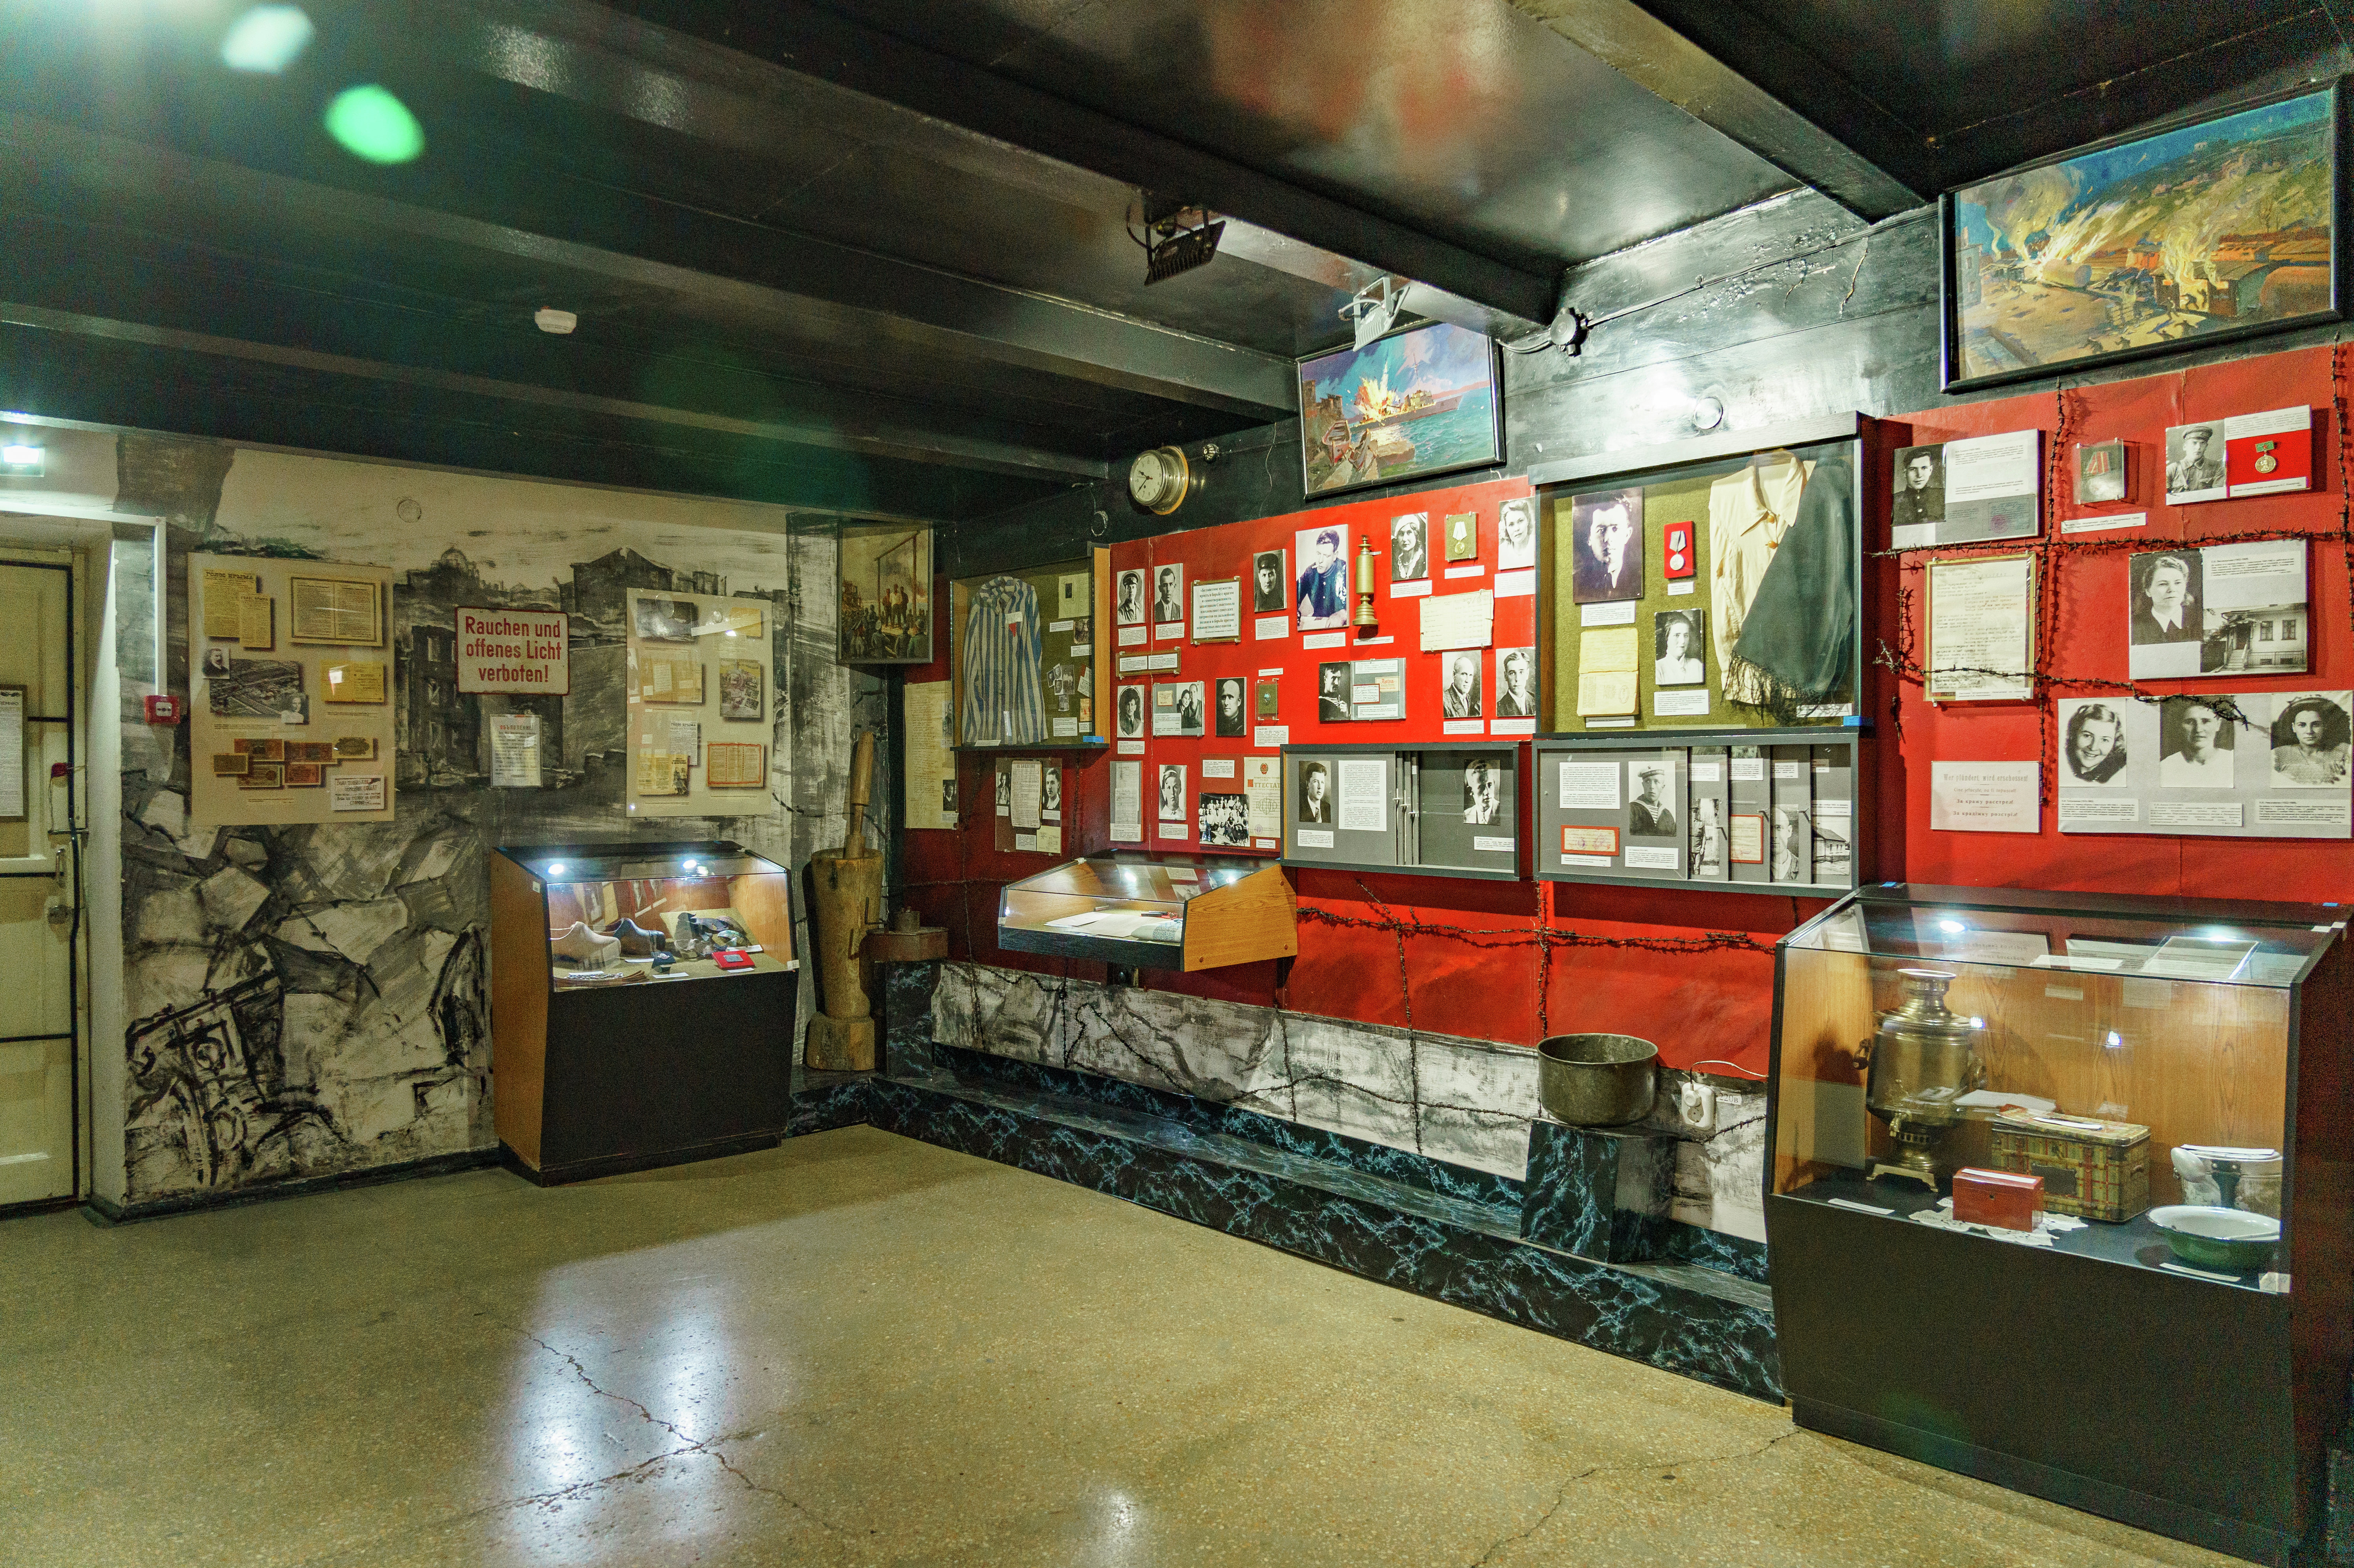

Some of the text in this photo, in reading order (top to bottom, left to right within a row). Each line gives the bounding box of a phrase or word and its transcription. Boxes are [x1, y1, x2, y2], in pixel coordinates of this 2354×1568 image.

[465, 616, 561, 638] Rauchen und
[466, 638, 561, 660] offenes Licht
[478, 663, 548, 682] verboten!
